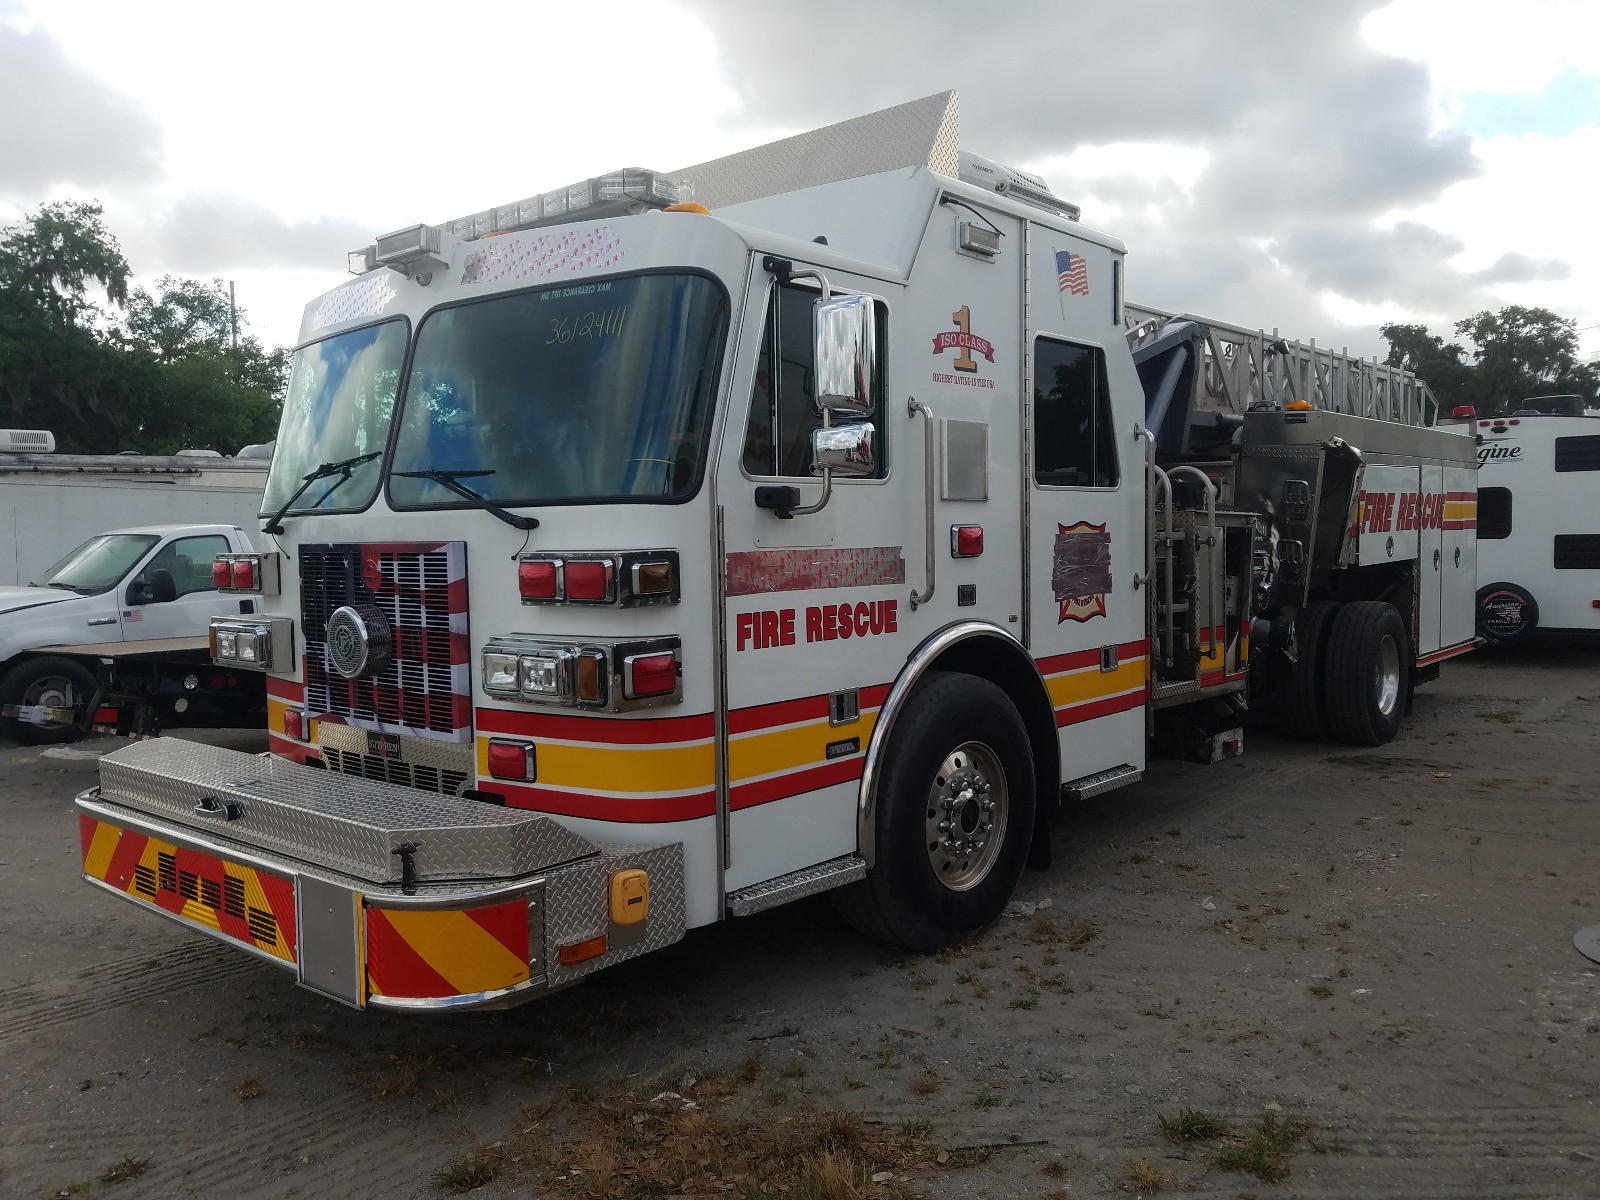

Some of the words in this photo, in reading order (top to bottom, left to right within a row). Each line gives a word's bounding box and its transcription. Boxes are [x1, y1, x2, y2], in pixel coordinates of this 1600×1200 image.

[940, 333, 957, 347] ISO
[959, 334, 988, 352] CLASS
[952, 305, 978, 374] 1
[932, 372, 954, 384] HIGHEST
[953, 375, 971, 386] RATING
[977, 378, 987, 388] THE
[1360, 492, 1396, 535] FIRE
[1395, 492, 1447, 532] RESCUE
[736, 608, 796, 652] FIRE
[805, 599, 898, 643] RESCUE
